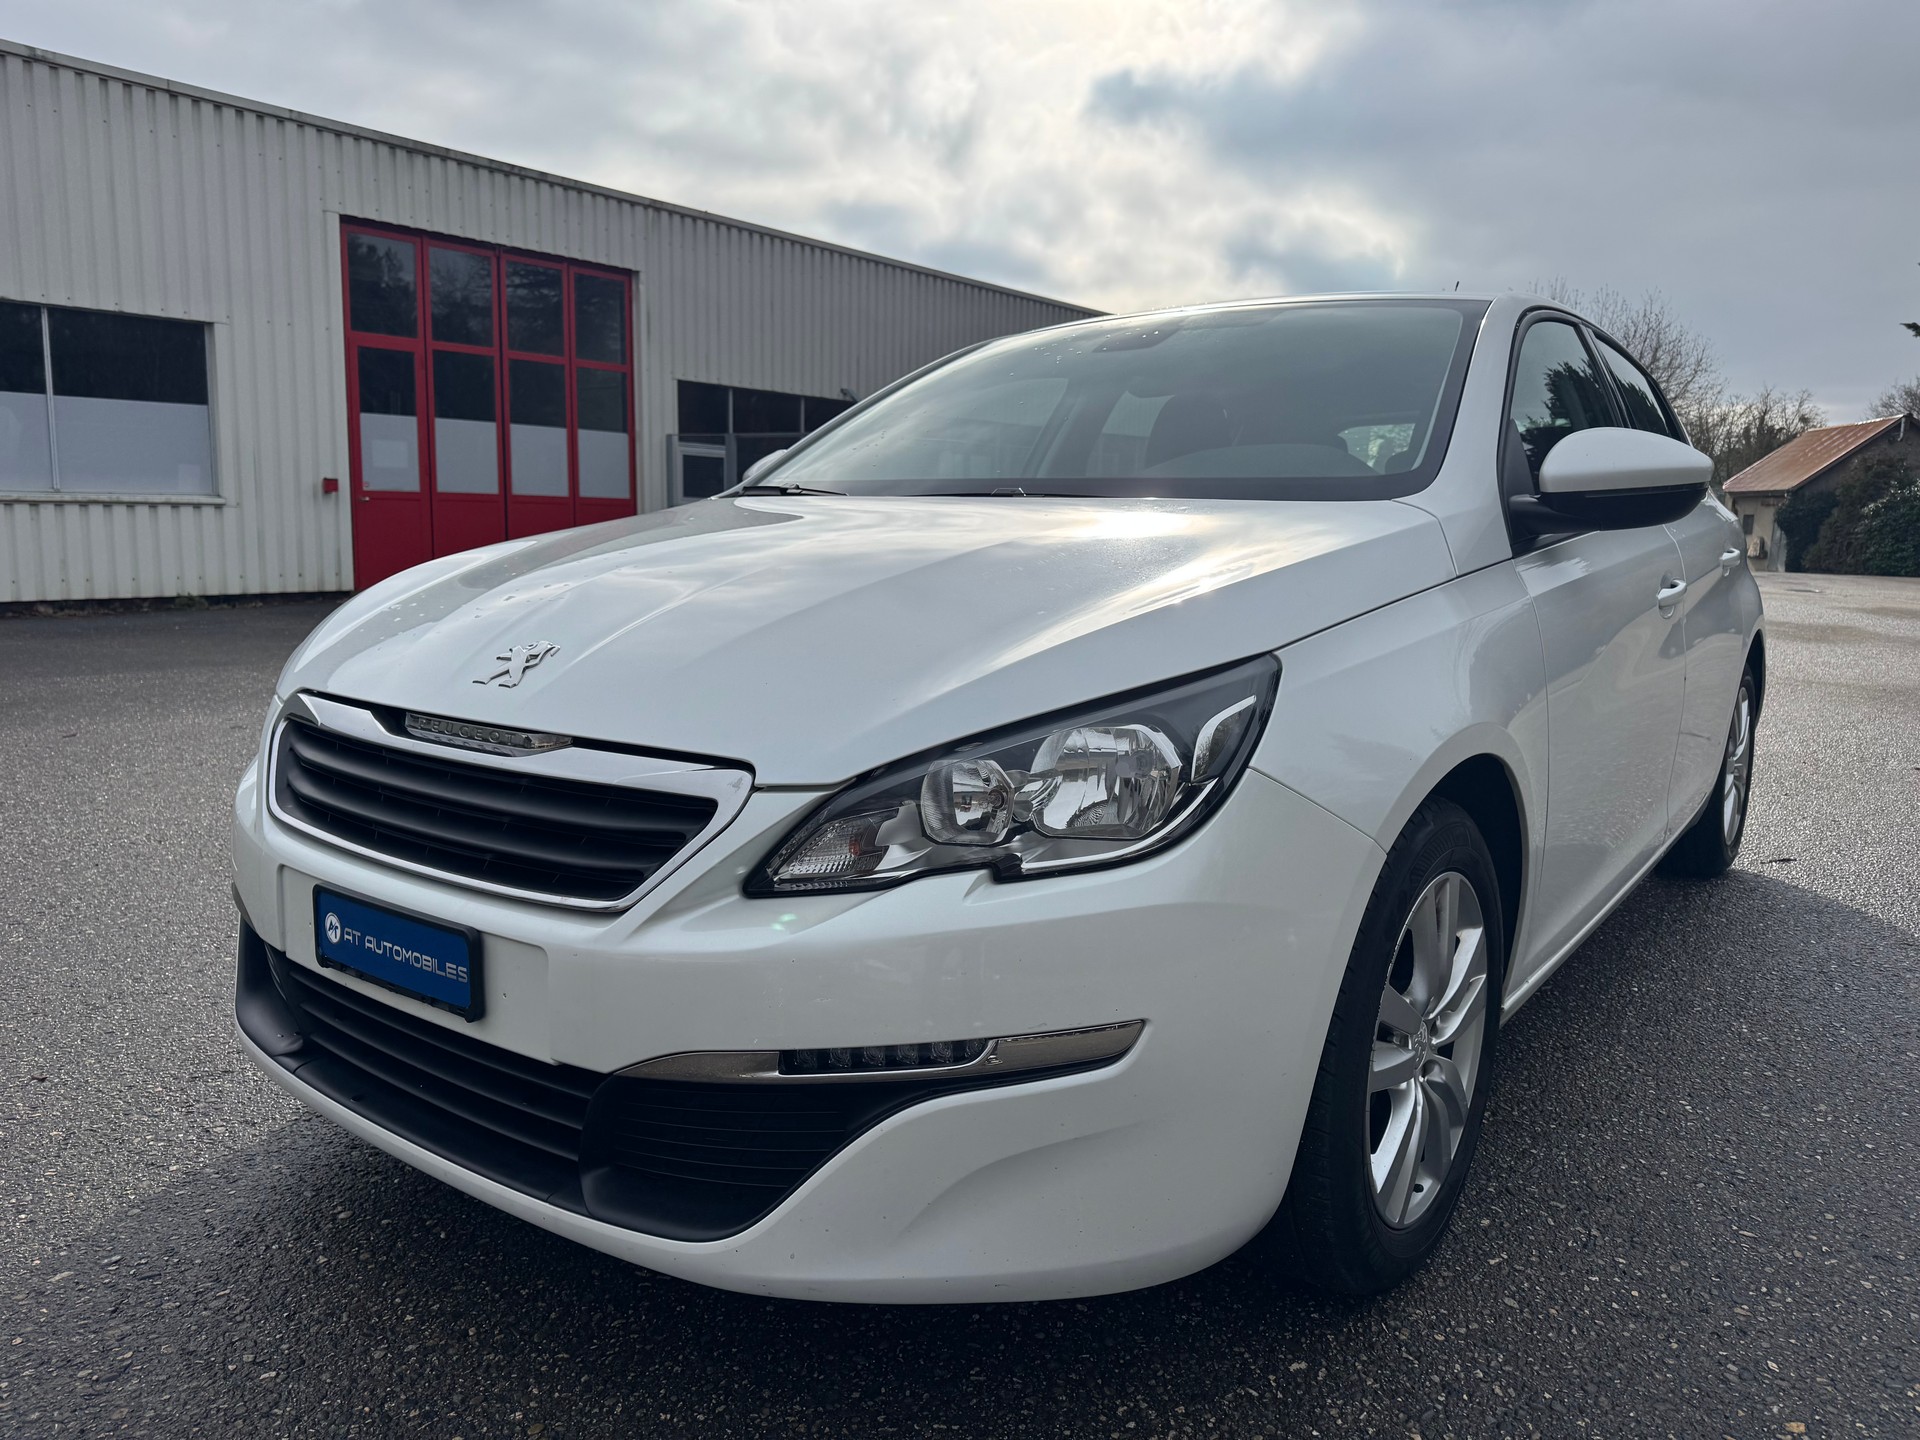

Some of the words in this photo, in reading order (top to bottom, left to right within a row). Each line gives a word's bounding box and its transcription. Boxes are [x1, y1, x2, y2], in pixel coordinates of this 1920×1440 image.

[418, 718, 518, 746] PEUGEOT
[344, 927, 361, 946] AT
[364, 935, 468, 983] AUTOMOBILES
